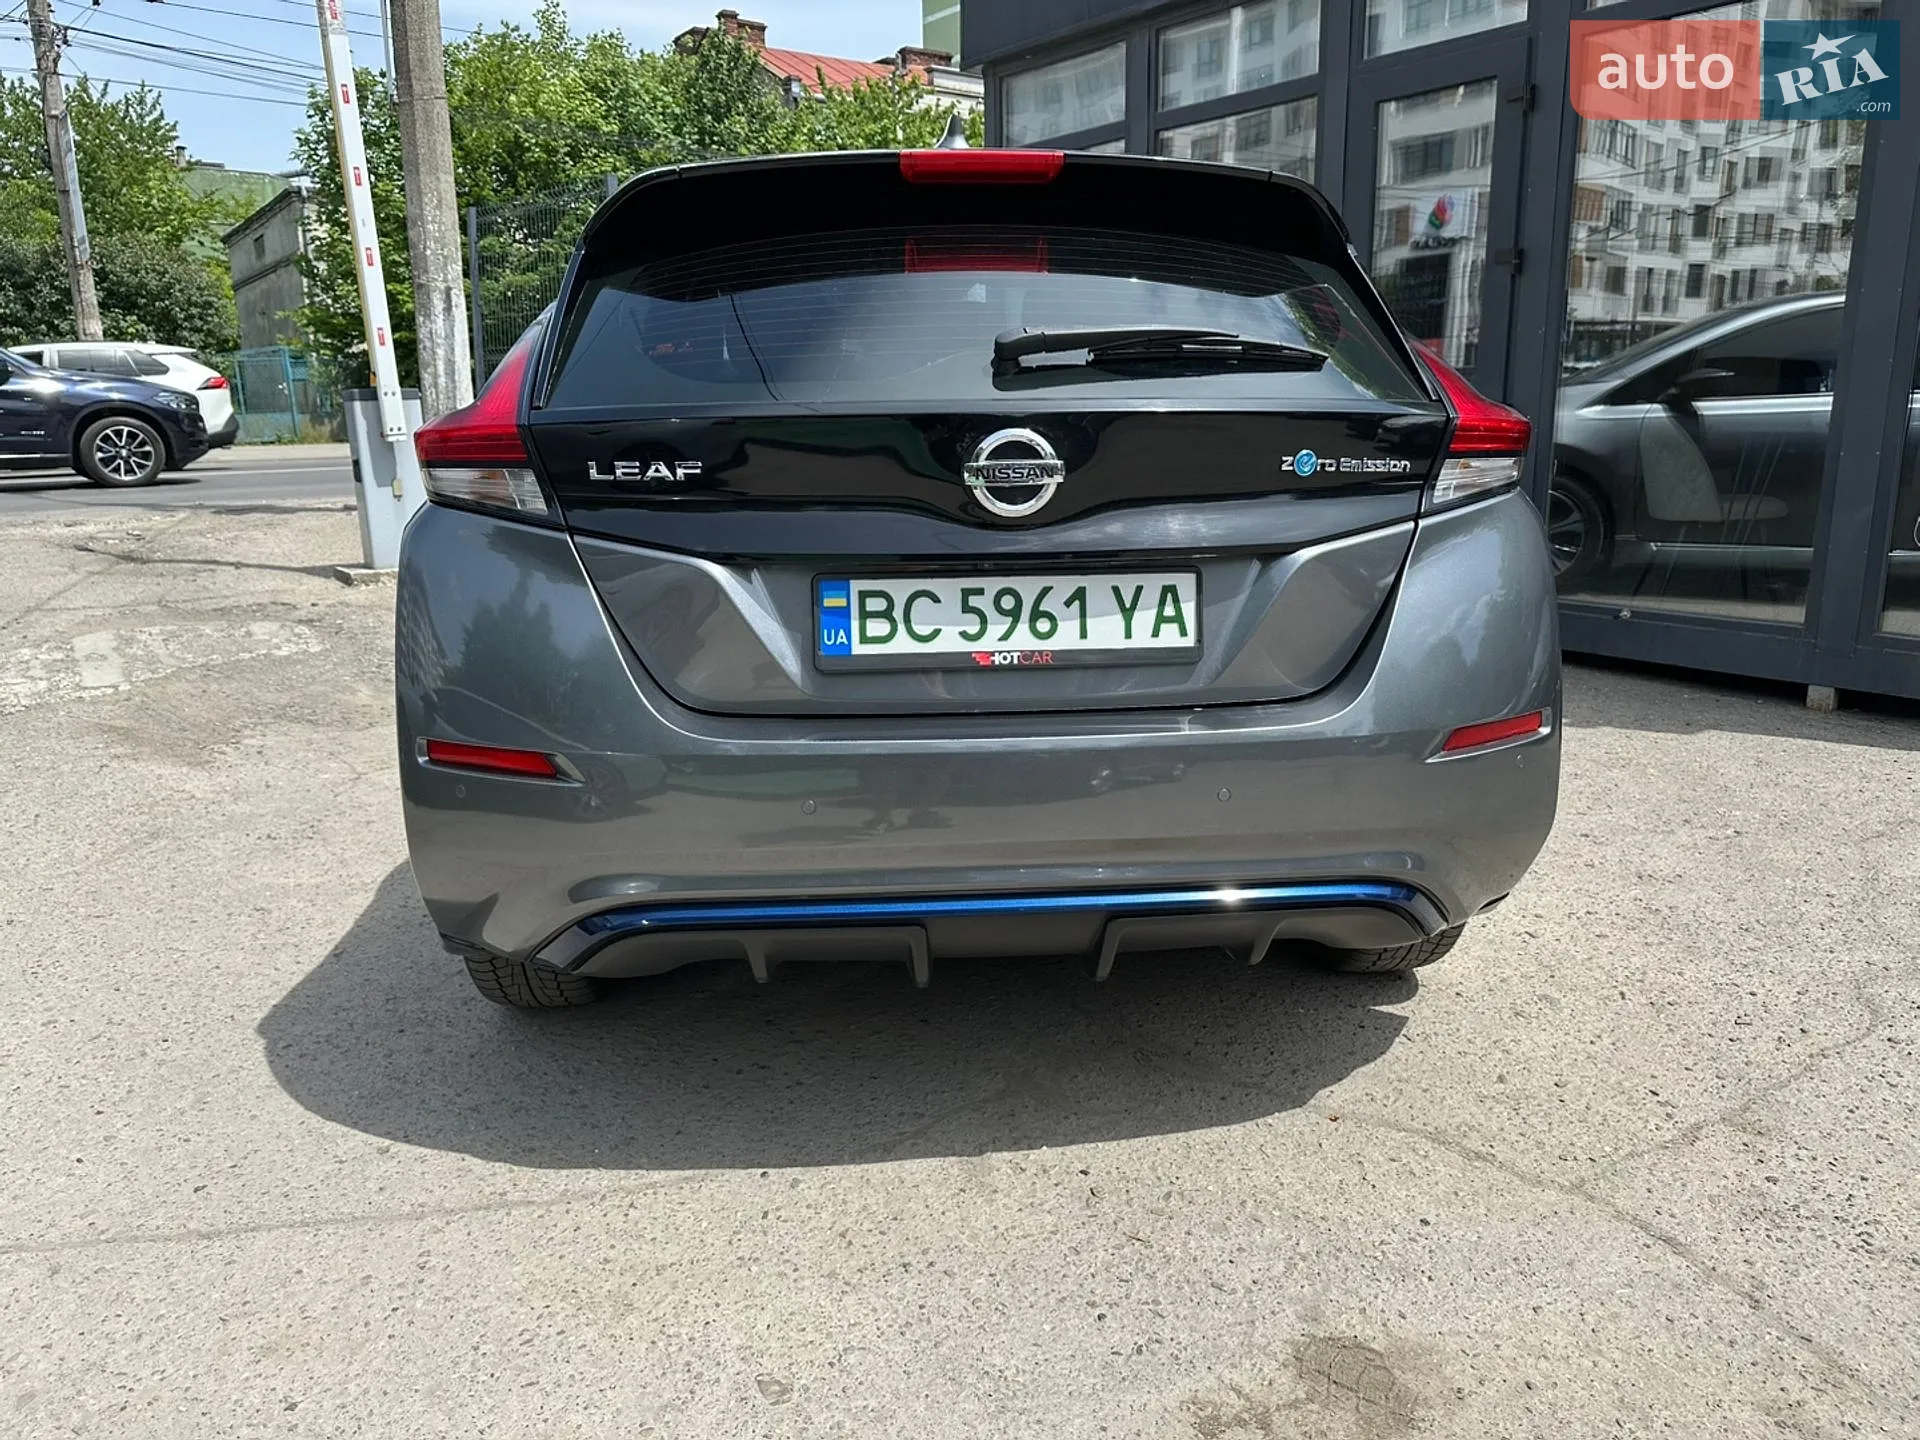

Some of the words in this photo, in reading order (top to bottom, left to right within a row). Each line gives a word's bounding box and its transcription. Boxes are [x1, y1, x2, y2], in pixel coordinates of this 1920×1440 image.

[587, 461, 702, 480] LEAF
[976, 467, 1054, 479] NISSAN
[1340, 457, 1411, 472] Emission
[858, 588, 942, 645] BC
[958, 585, 1089, 641] 5961
[1111, 584, 1189, 639] YA
[824, 628, 849, 646] UA
